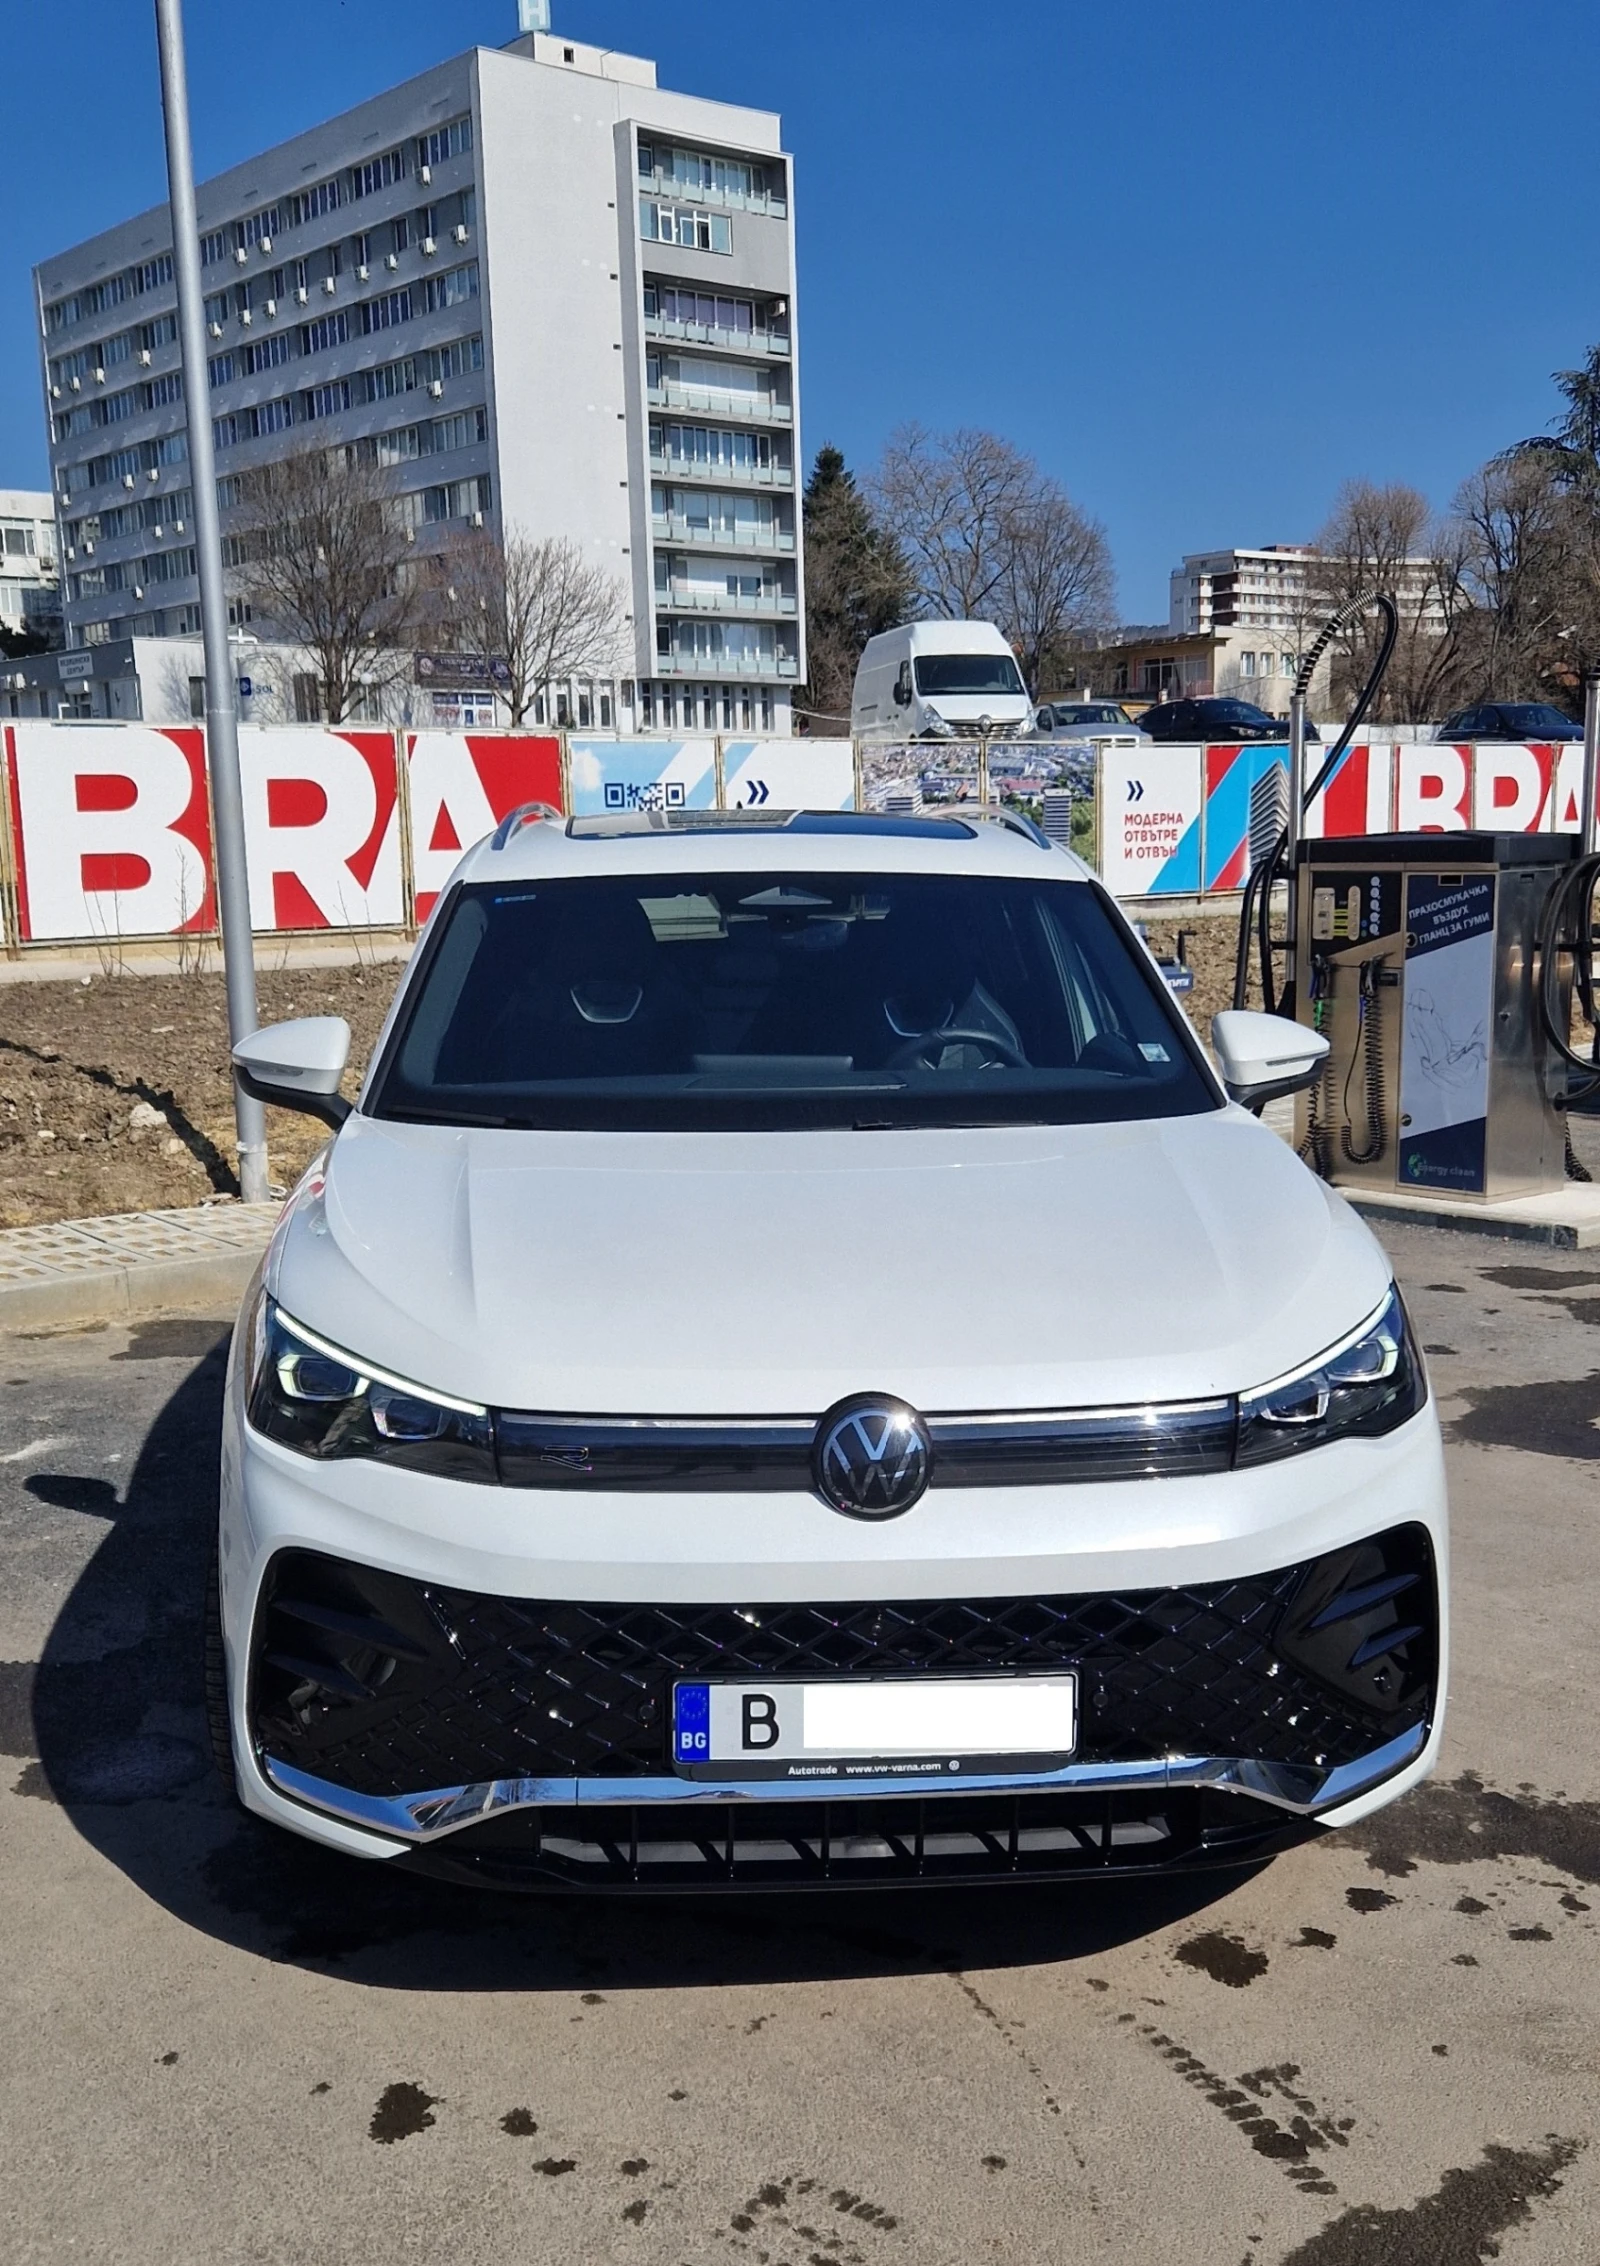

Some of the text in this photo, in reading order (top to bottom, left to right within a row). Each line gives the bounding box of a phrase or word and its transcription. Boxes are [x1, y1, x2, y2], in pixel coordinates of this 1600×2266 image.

[1124, 812, 1184, 828] МОДЕРНА
[1124, 828, 1178, 843] ОТВЪТРЕ
[1124, 845, 1178, 860] И ОТВЪН
[1408, 884, 1489, 920] ПРАХОСМУКАЧКА
[1432, 904, 1470, 925] ВЪЗДУХ
[1419, 911, 1490, 945] ГЛАНЦ ЗА ГУМИ
[681, 1732, 707, 1749] BG
[788, 1765, 838, 1776] Autotrade
[846, 1761, 941, 1774] www.vw-varna.com
